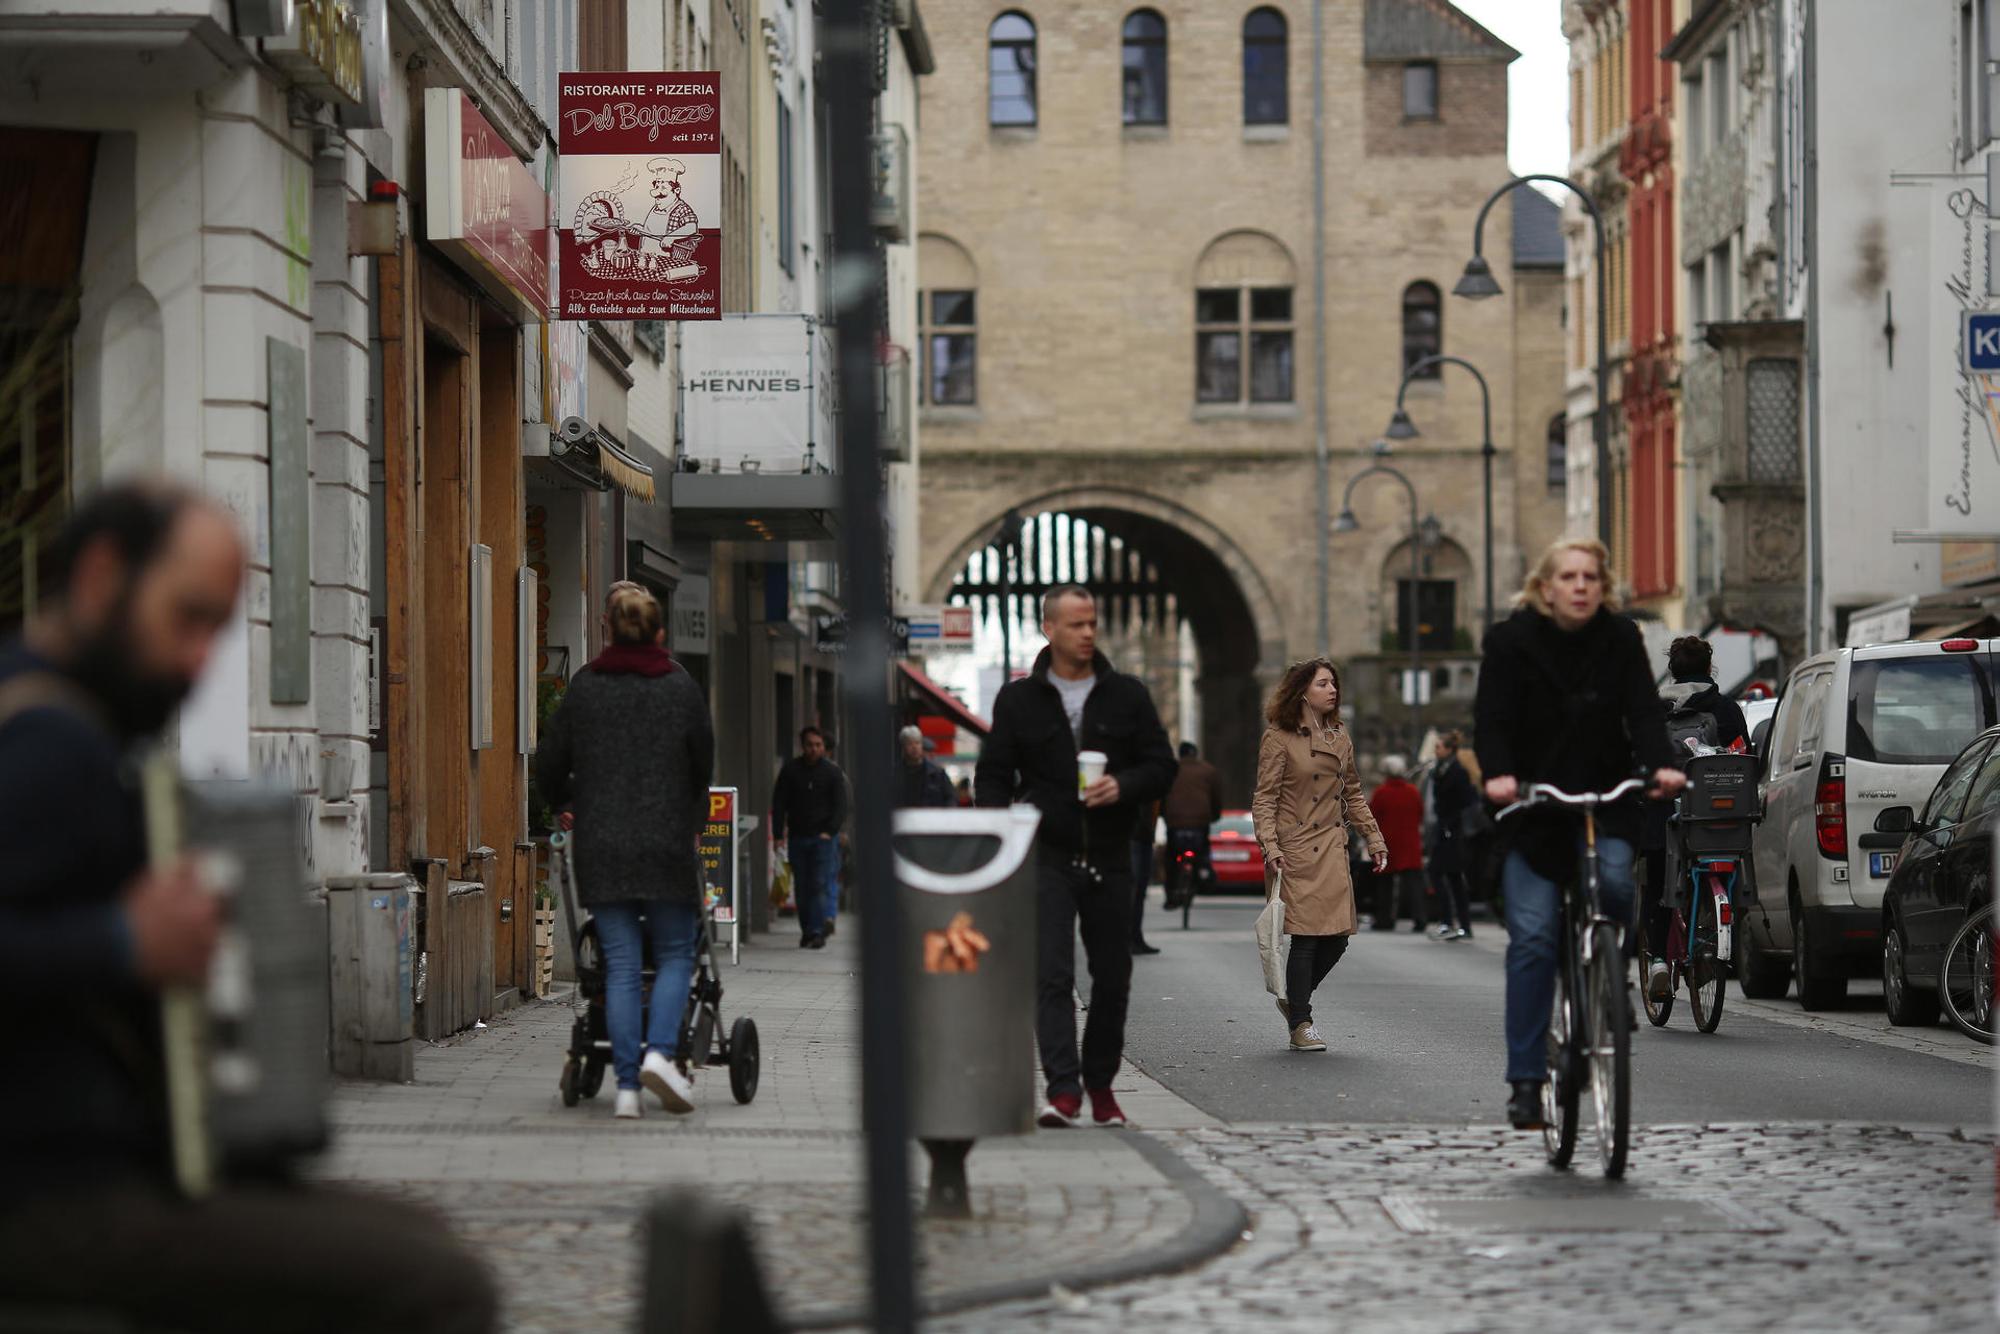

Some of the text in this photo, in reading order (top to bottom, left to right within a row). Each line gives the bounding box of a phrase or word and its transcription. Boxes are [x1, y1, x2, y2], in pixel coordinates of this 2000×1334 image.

[563, 84, 714, 96] RISTORANTE PIZZERIA
[564, 102, 715, 142] Del Bajazzo
[672, 133, 714, 142] seit 1974
[566, 288, 606, 301] Pizza
[605, 288, 631, 304] frisch
[632, 291, 650, 301] aus
[652, 288, 668, 301] dem
[567, 303, 715, 314] Alle Gerichte auch zum Mitnehmen
[1975, 328, 2000, 355] K
[690, 379, 800, 392] HENNES
[709, 795, 726, 817] P
